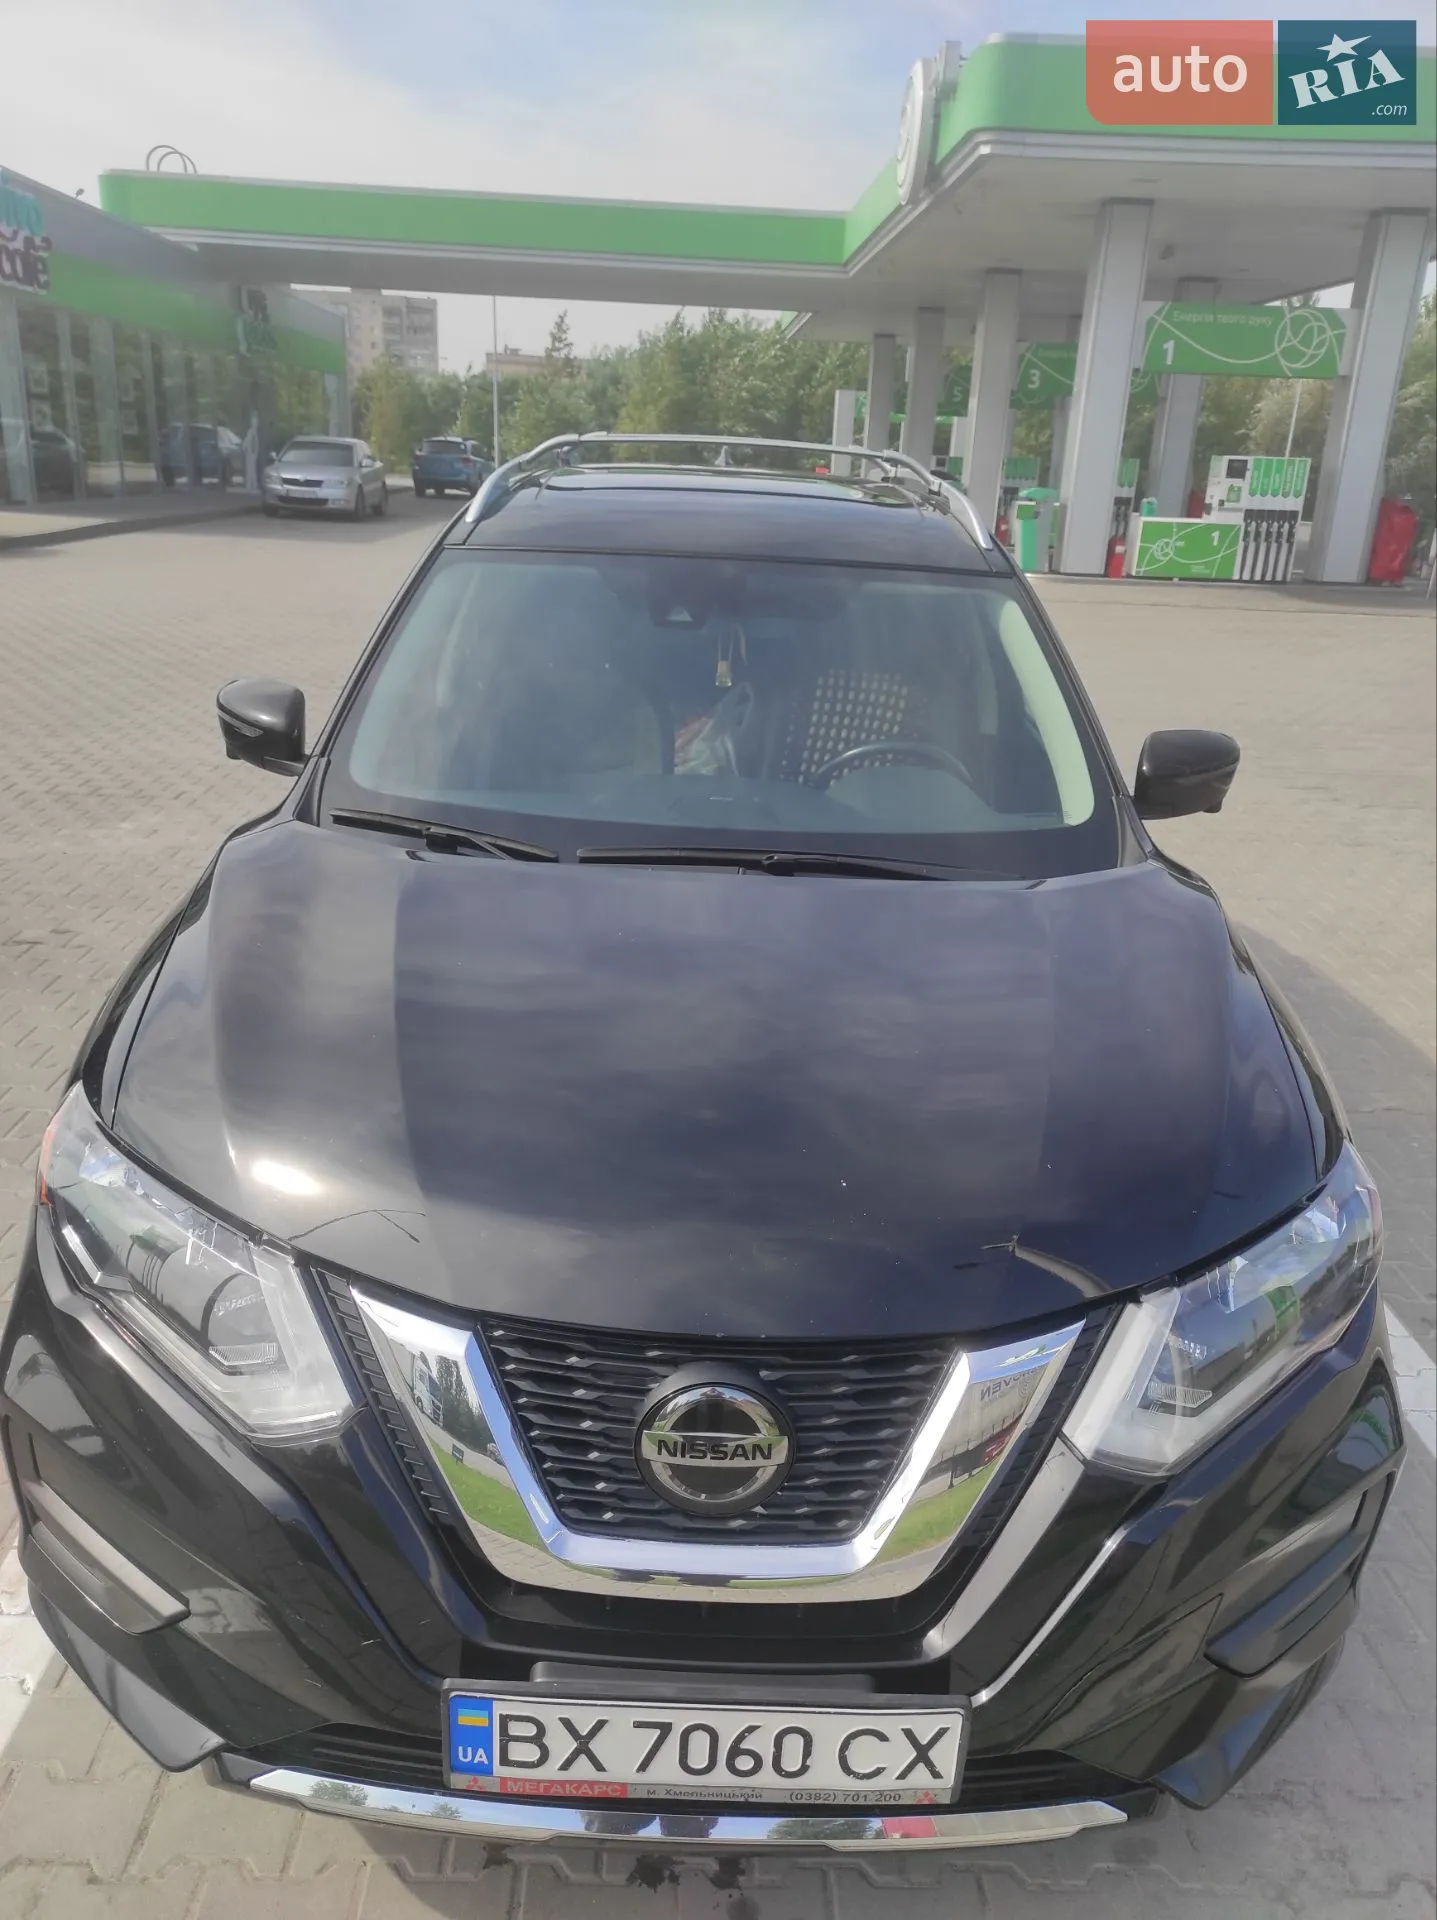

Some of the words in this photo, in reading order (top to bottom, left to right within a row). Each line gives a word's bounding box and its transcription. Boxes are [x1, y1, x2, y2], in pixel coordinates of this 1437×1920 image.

[1162, 339, 1175, 366] 1
[1027, 369, 1041, 389] 3
[1211, 530, 1220, 546] 1
[656, 1439, 773, 1461] NISSAN
[457, 1746, 489, 1765] UA
[498, 1713, 609, 1773] BX
[632, 1720, 813, 1779] 7060
[837, 1726, 951, 1780] CX
[506, 1780, 621, 1797] МЕГАКАРС
[789, 1792, 837, 1802] (0382)
